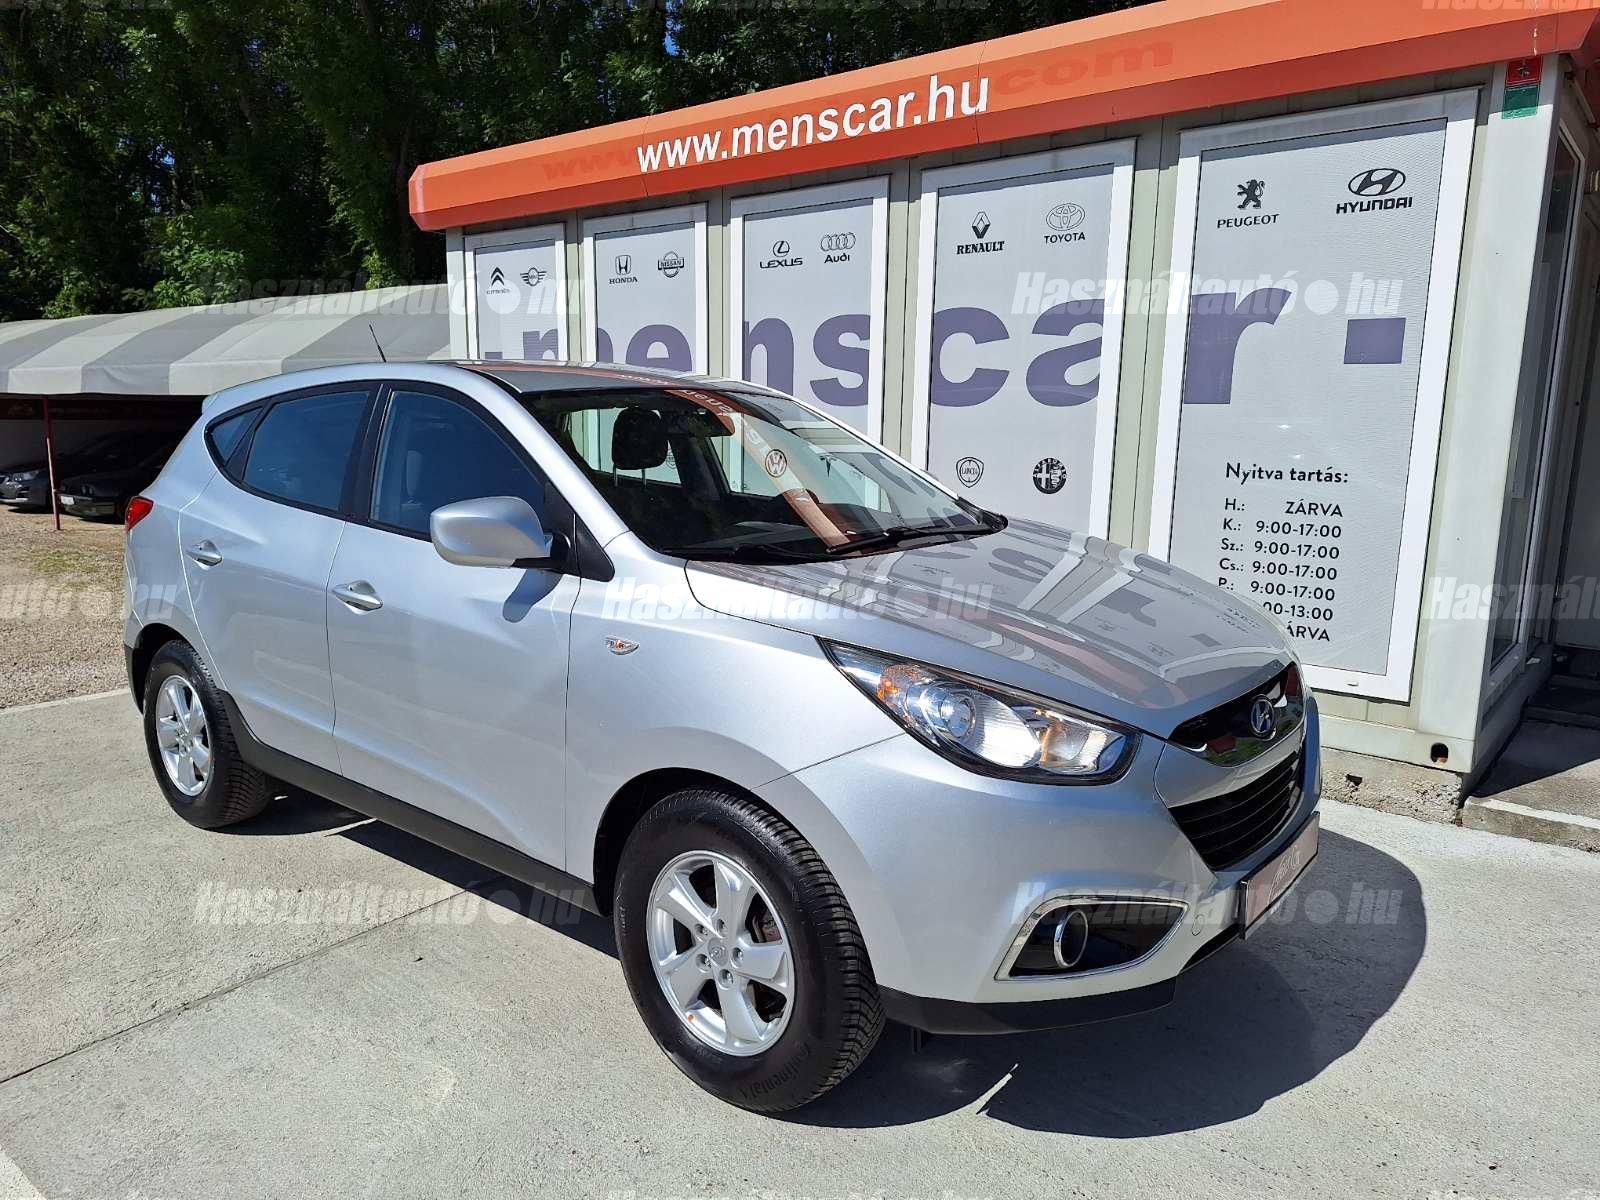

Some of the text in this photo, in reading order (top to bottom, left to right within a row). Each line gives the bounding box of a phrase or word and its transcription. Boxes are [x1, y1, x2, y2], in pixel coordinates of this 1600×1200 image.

[636, 75, 989, 174] www.menscar.hu
[1336, 197, 1413, 214] HYUNDAI
[1217, 214, 1280, 228] PEUGEOT
[1044, 232, 1086, 244] TOYOTA
[956, 241, 1005, 254] RENAULT
[759, 257, 803, 269] LEXUS
[824, 254, 850, 264] Audi
[608, 276, 639, 285] HONDA
[1226, 462, 1349, 485] Nyitva tartás:
[1224, 498, 1344, 518] H.: ZÁRVA
[1222, 518, 1342, 539] K.: 9:00-17:00
[1220, 538, 1340, 560] Sz.: 9:00-17:00
[1219, 558, 1338, 580] Cs.: 9:00-17:00
[1217, 577, 1336, 601] P.: 9:00-17:00
